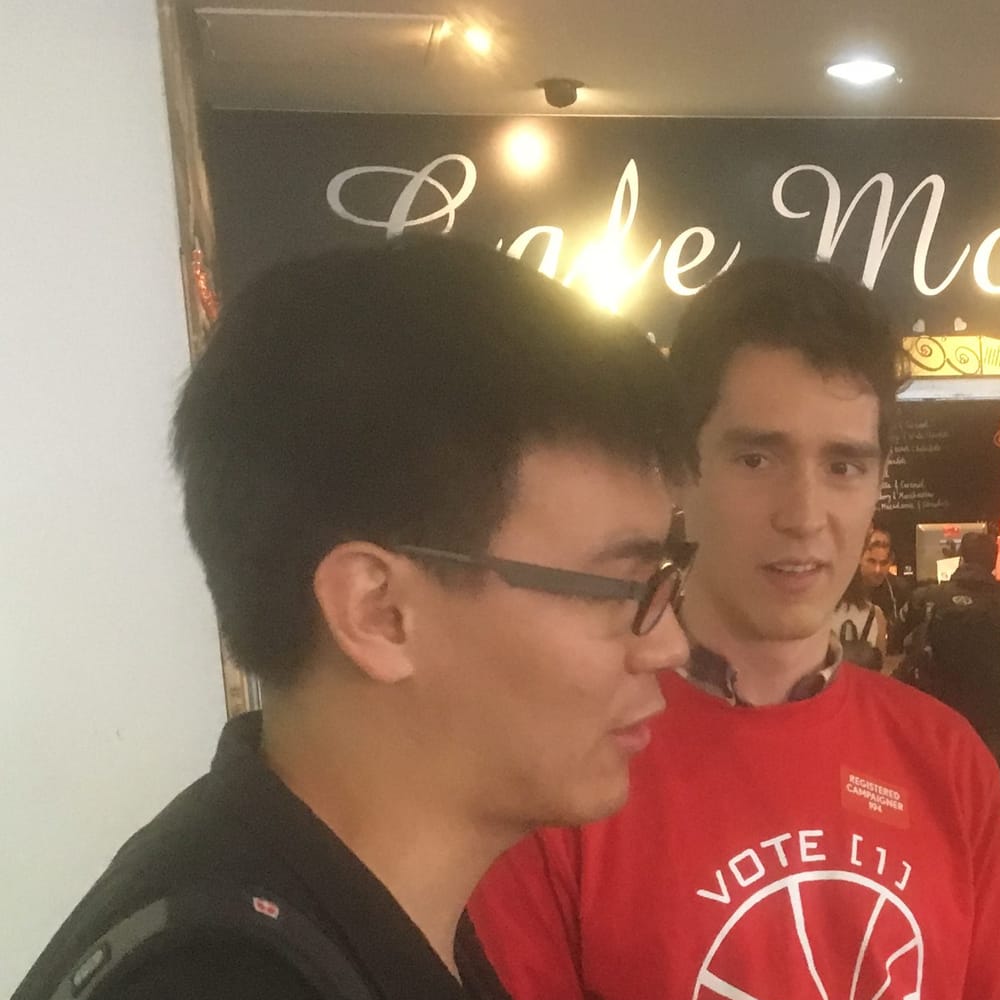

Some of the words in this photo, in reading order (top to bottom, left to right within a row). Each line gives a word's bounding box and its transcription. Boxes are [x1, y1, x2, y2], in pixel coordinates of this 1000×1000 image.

[846, 783, 904, 812] CAMPAIGNER
[848, 774, 901, 801] REGISTERED
[697, 829, 826, 904] VOTE
[850, 833, 912, 891] [1]
